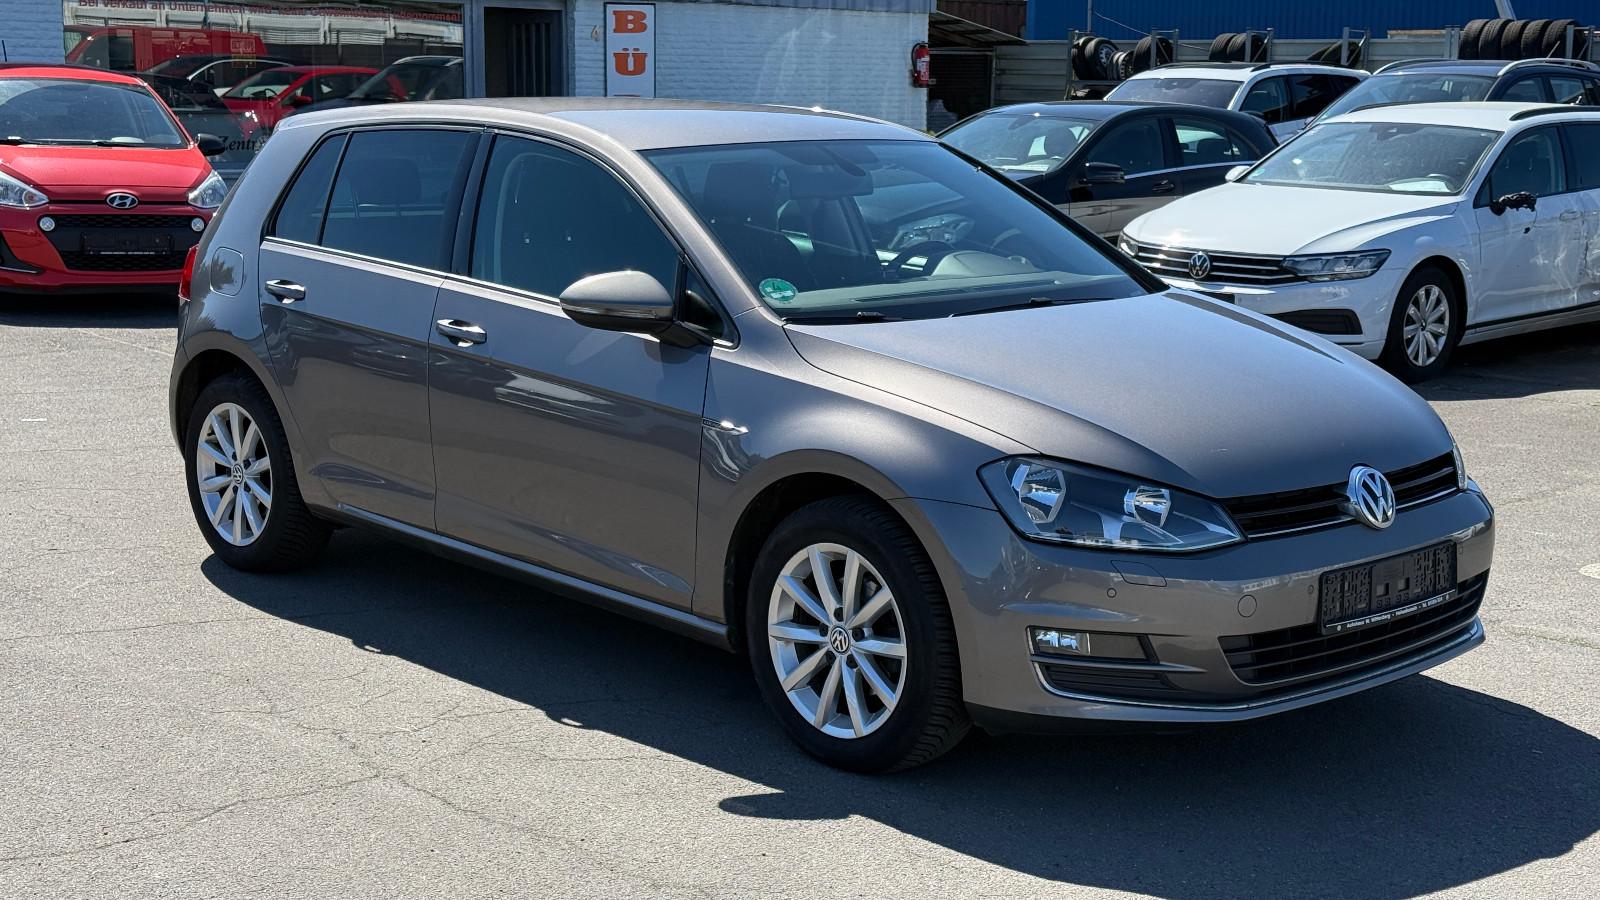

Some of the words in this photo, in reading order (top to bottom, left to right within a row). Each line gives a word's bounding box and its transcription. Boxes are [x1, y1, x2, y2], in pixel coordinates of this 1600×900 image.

[103, 0, 148, 10] Verkauf
[151, 2, 165, 10] an
[613, 10, 648, 97] BÜ
[218, 135, 258, 151] Zentr
